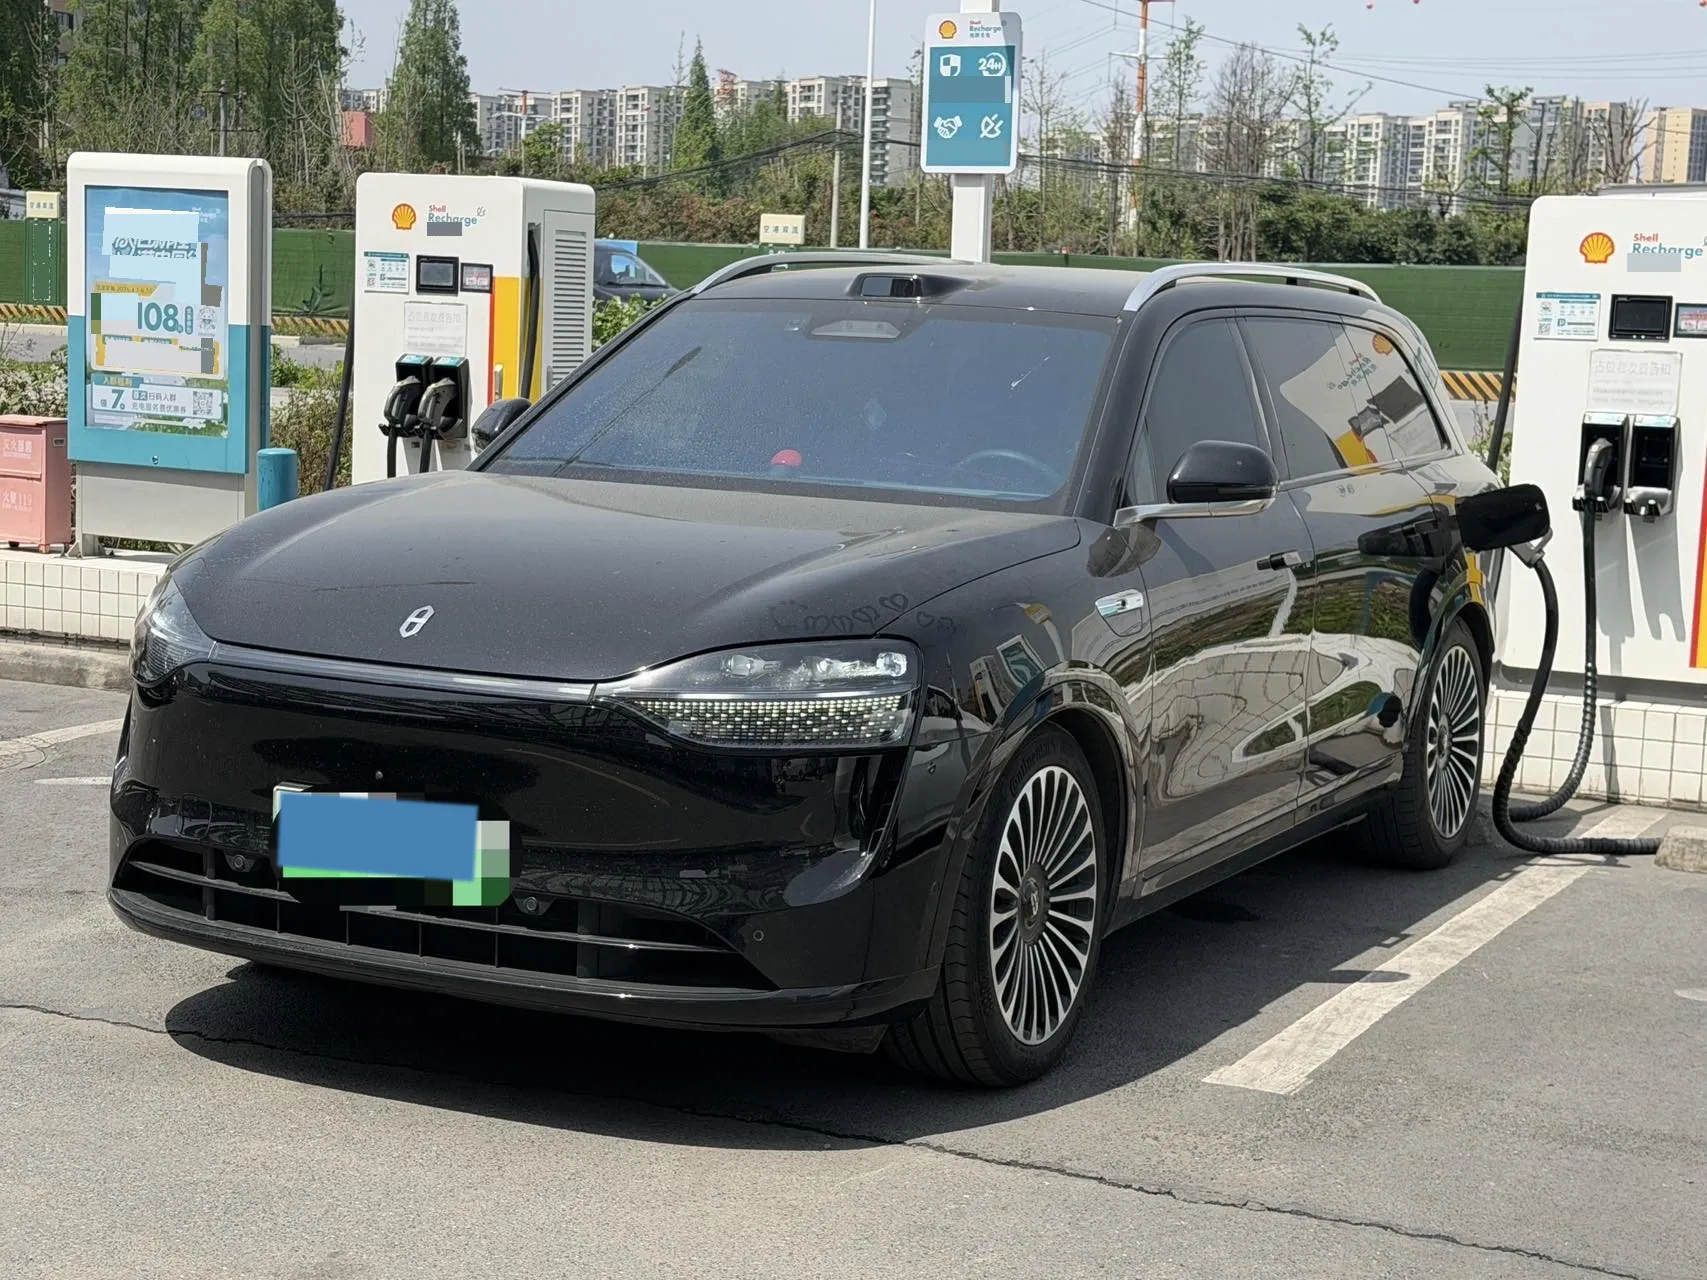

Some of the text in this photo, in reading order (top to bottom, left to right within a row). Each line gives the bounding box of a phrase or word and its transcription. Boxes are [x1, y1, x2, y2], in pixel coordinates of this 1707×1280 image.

[428, 204, 446, 213] Shell
[428, 212, 477, 227] Recharge
[1633, 232, 1658, 242] Shell
[1631, 242, 1703, 260] Recharge
